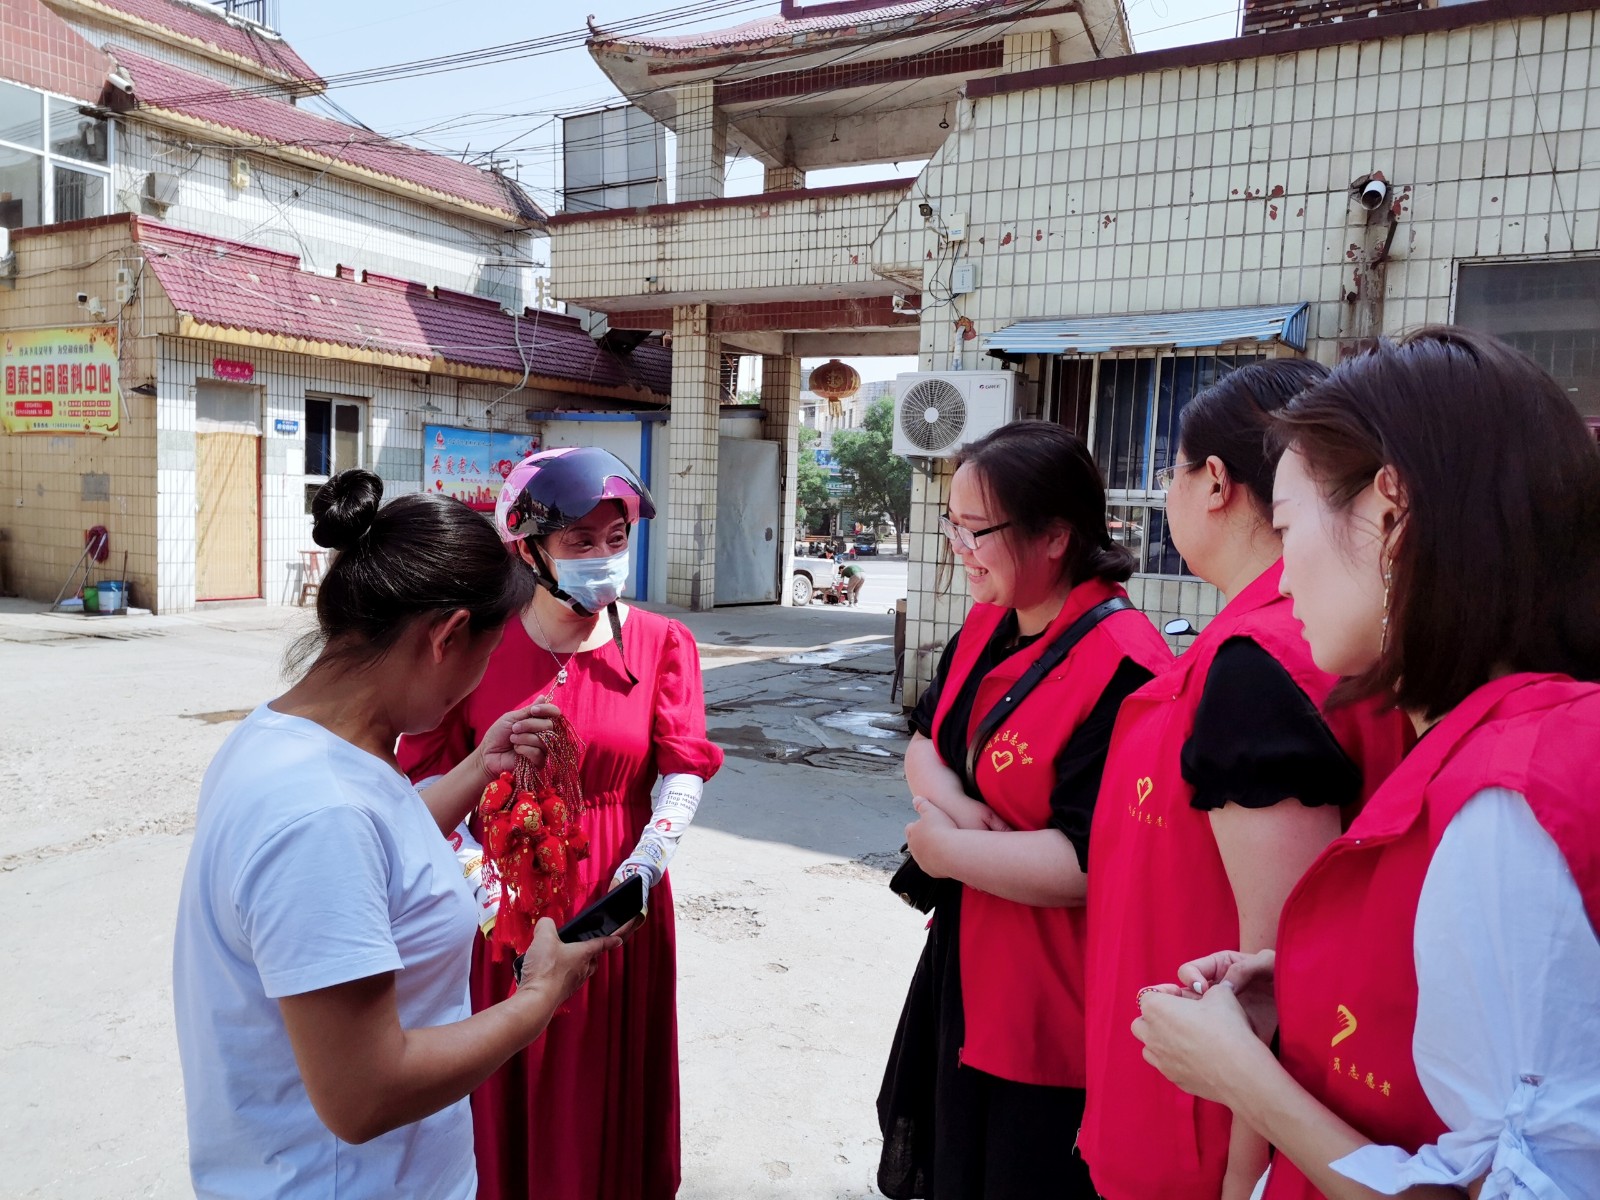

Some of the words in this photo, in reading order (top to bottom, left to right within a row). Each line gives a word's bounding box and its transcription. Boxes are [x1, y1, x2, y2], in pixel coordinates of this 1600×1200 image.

[5, 363, 111, 395] 国泰日间照料中心
